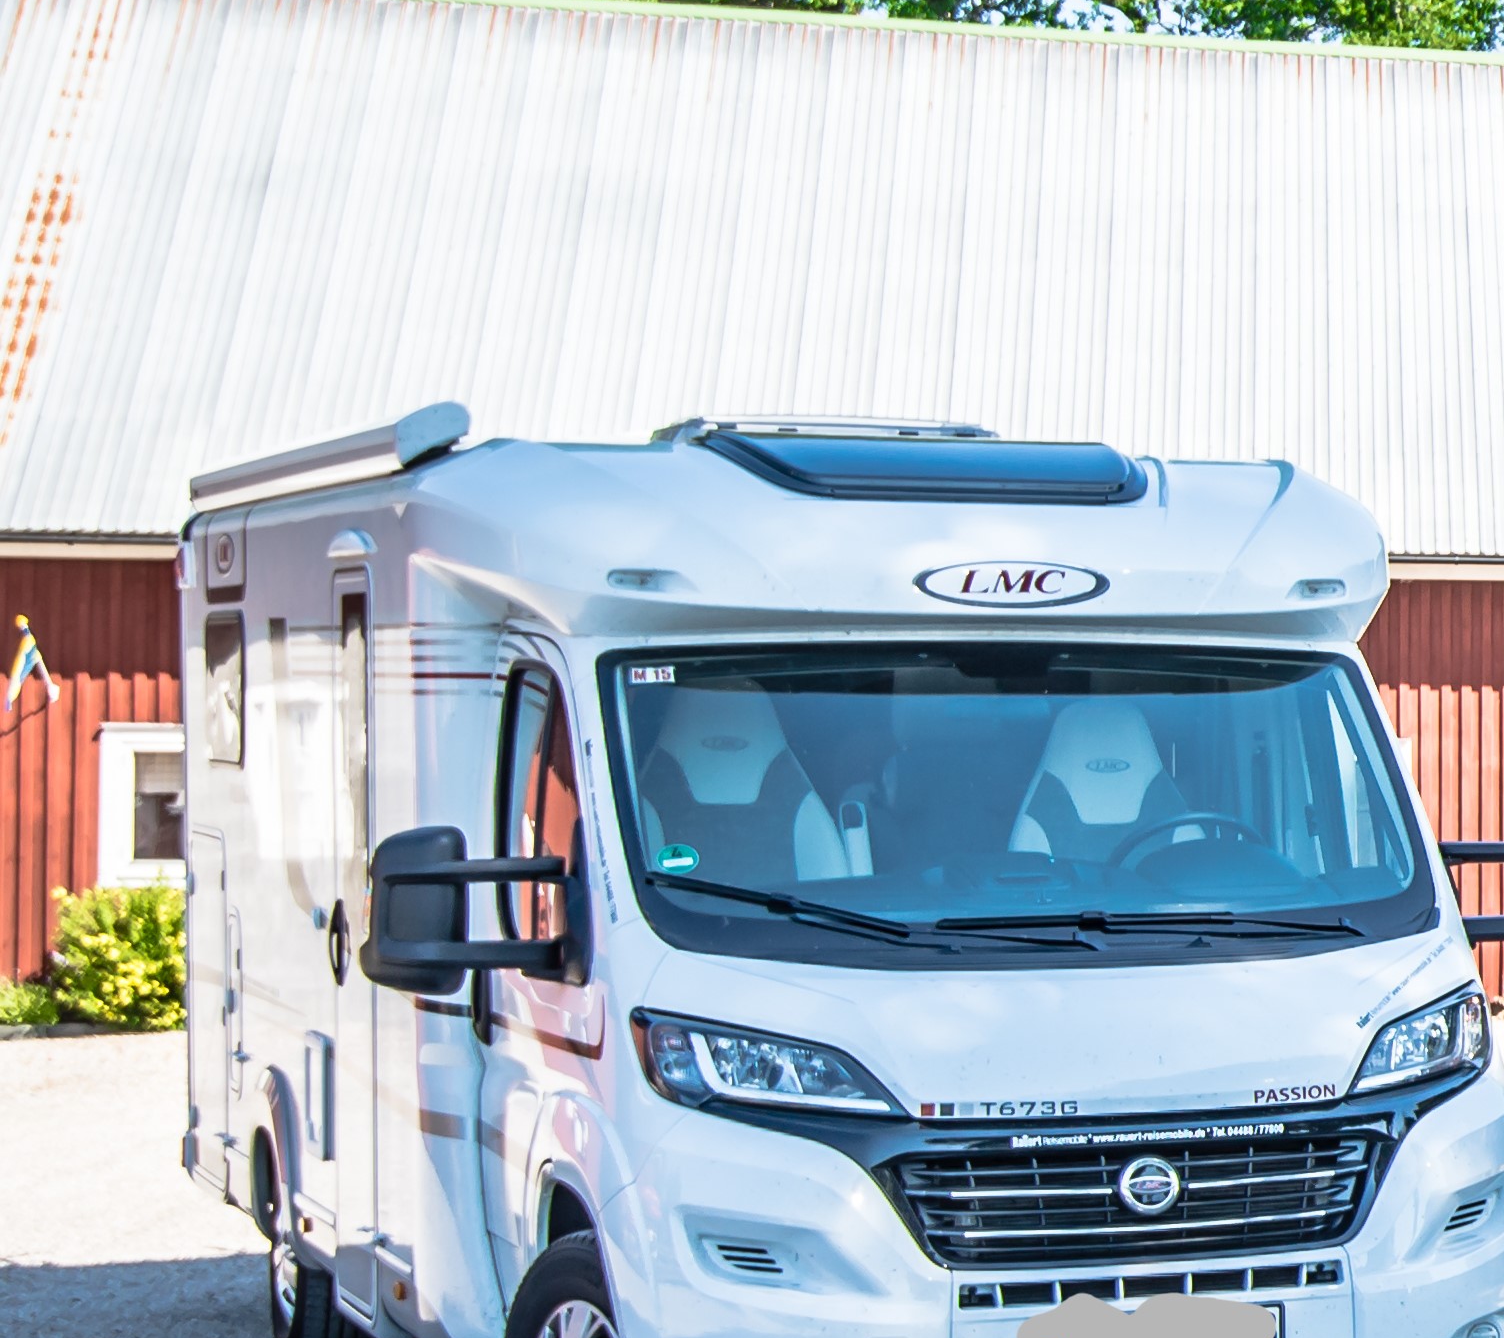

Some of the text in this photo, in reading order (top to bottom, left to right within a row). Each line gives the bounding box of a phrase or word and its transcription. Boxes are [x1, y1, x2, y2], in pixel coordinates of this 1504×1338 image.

[960, 569, 1066, 594] LMC
[1253, 1084, 1337, 1104] PASSION
[979, 1101, 1079, 1117] T673G
